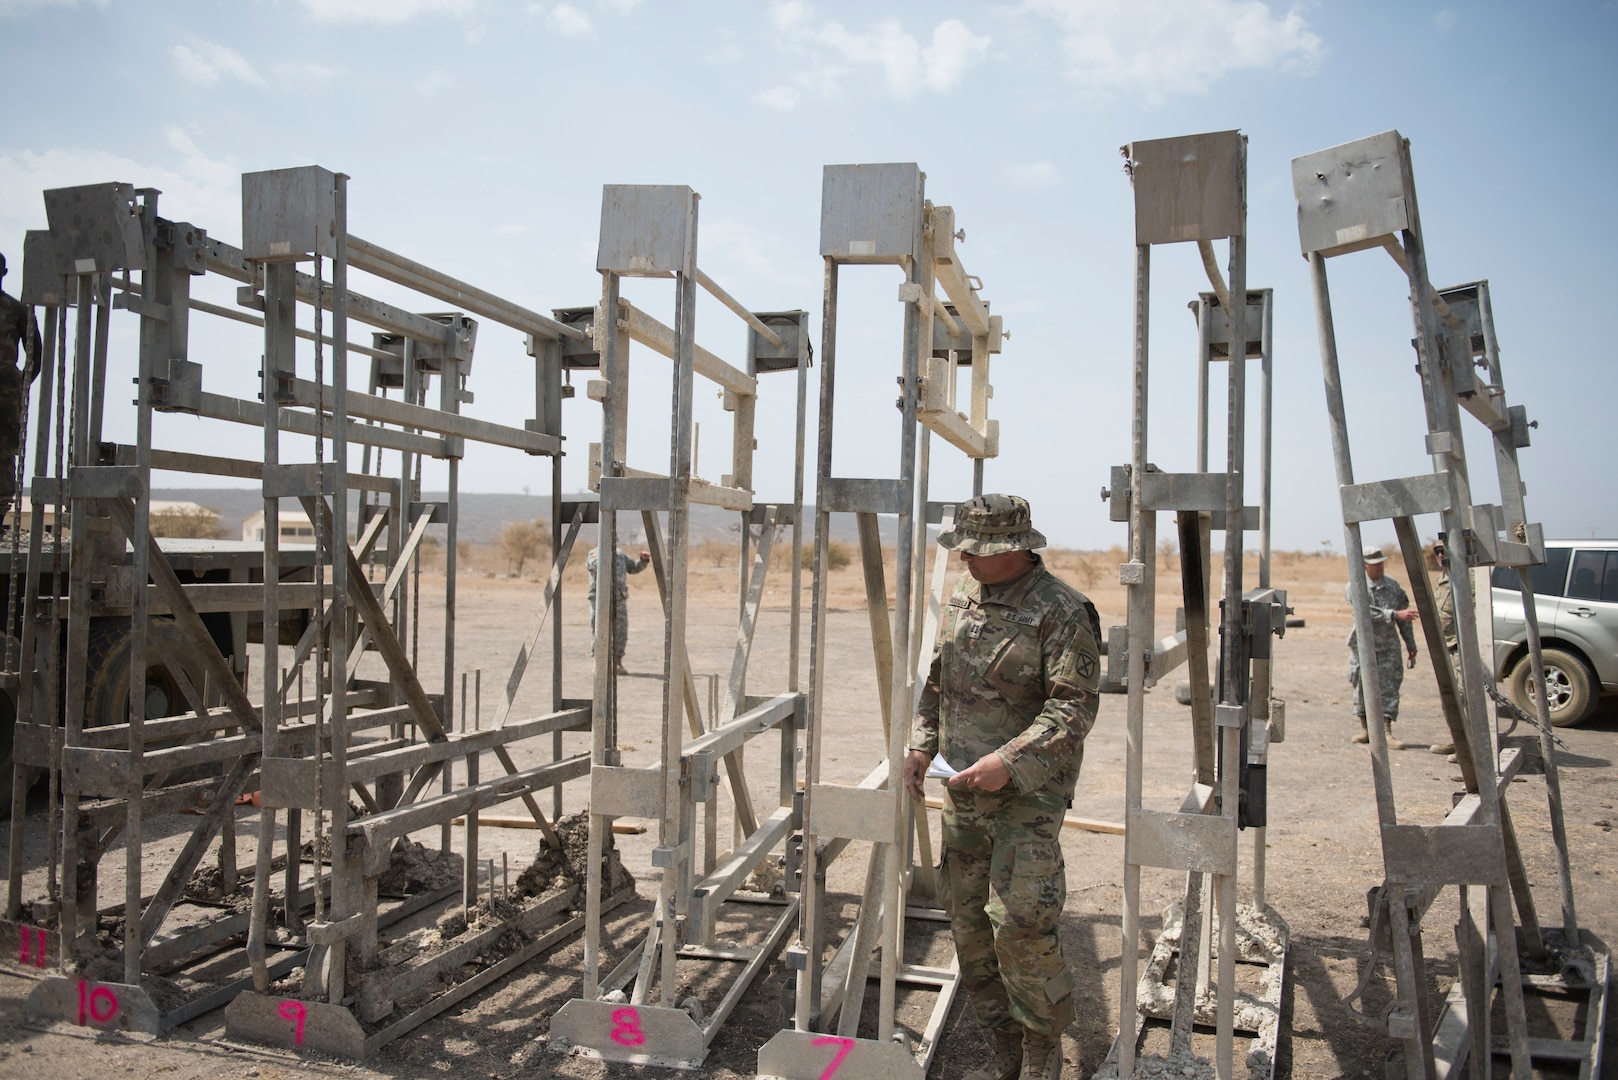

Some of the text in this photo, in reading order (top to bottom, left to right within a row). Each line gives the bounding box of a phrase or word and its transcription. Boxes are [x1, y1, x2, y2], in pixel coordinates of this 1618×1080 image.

[1018, 614, 1034, 624] ARMY
[20, 925, 46, 968] 11
[77, 980, 118, 1025] 10
[278, 1000, 307, 1045] 9
[609, 1006, 646, 1047] 8
[811, 1035, 856, 1080] 7
